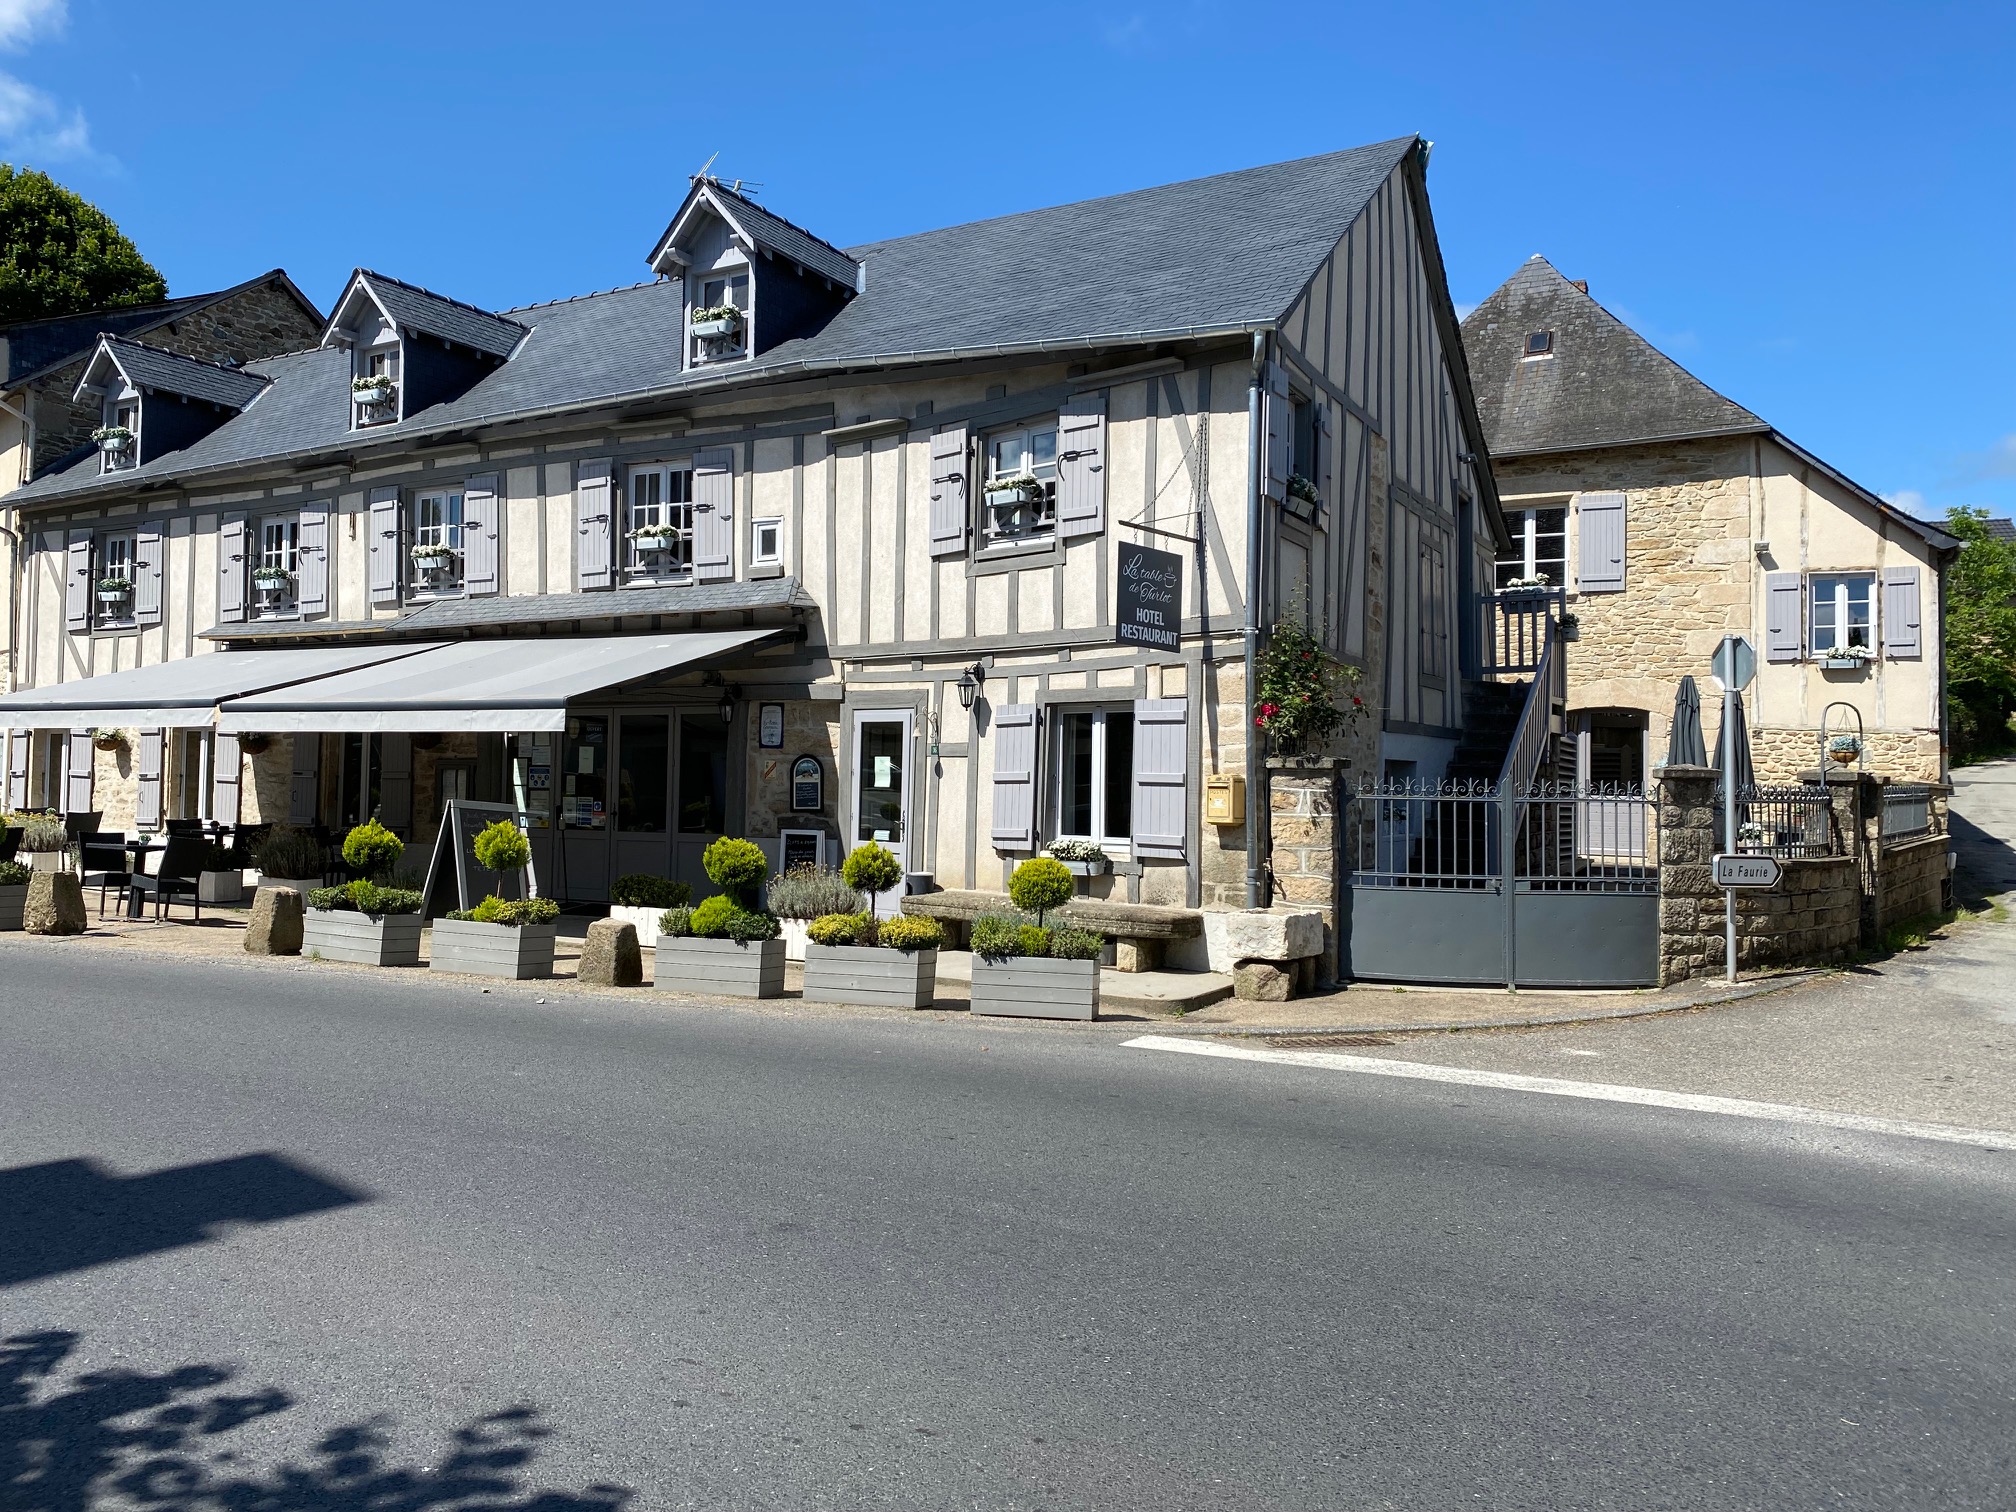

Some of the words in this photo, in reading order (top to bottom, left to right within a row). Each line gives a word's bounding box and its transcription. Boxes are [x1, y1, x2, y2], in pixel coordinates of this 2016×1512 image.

[1123, 553, 1139, 580] La
[1140, 568, 1163, 582] table
[1129, 582, 1140, 594] de
[1140, 581, 1173, 604] Turlot
[1136, 607, 1165, 626] HOTEL
[1121, 623, 1178, 646] RESTAURANT
[1722, 865, 1733, 877] La
[1738, 865, 1768, 877] Faurie
